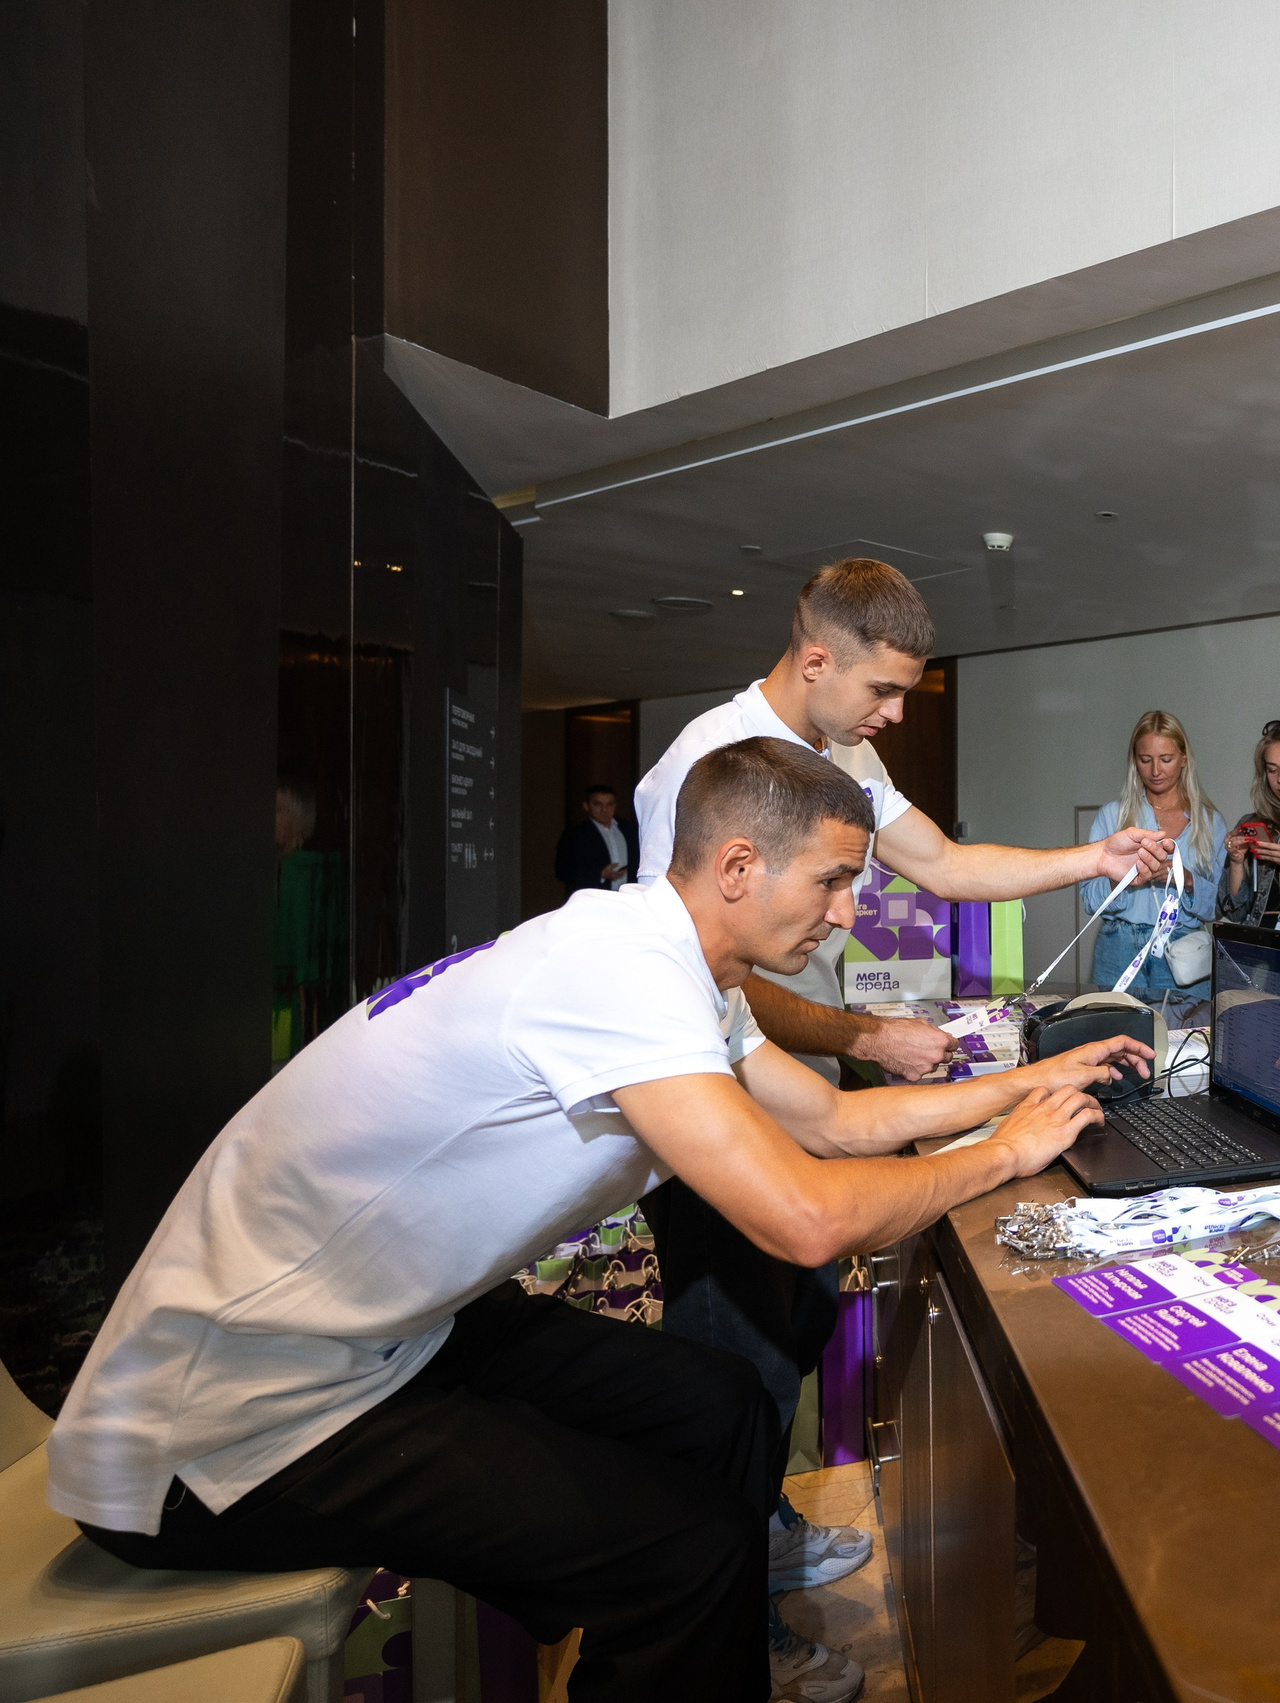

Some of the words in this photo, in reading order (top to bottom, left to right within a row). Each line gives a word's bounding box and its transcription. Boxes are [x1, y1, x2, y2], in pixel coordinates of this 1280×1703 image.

[856, 972, 890, 982] мега
[856, 980, 900, 992] среда
[1170, 1305, 1207, 1328] Сергей
[1232, 1348, 1268, 1372] Елена
[1216, 1352, 1274, 1393] Коваленко
